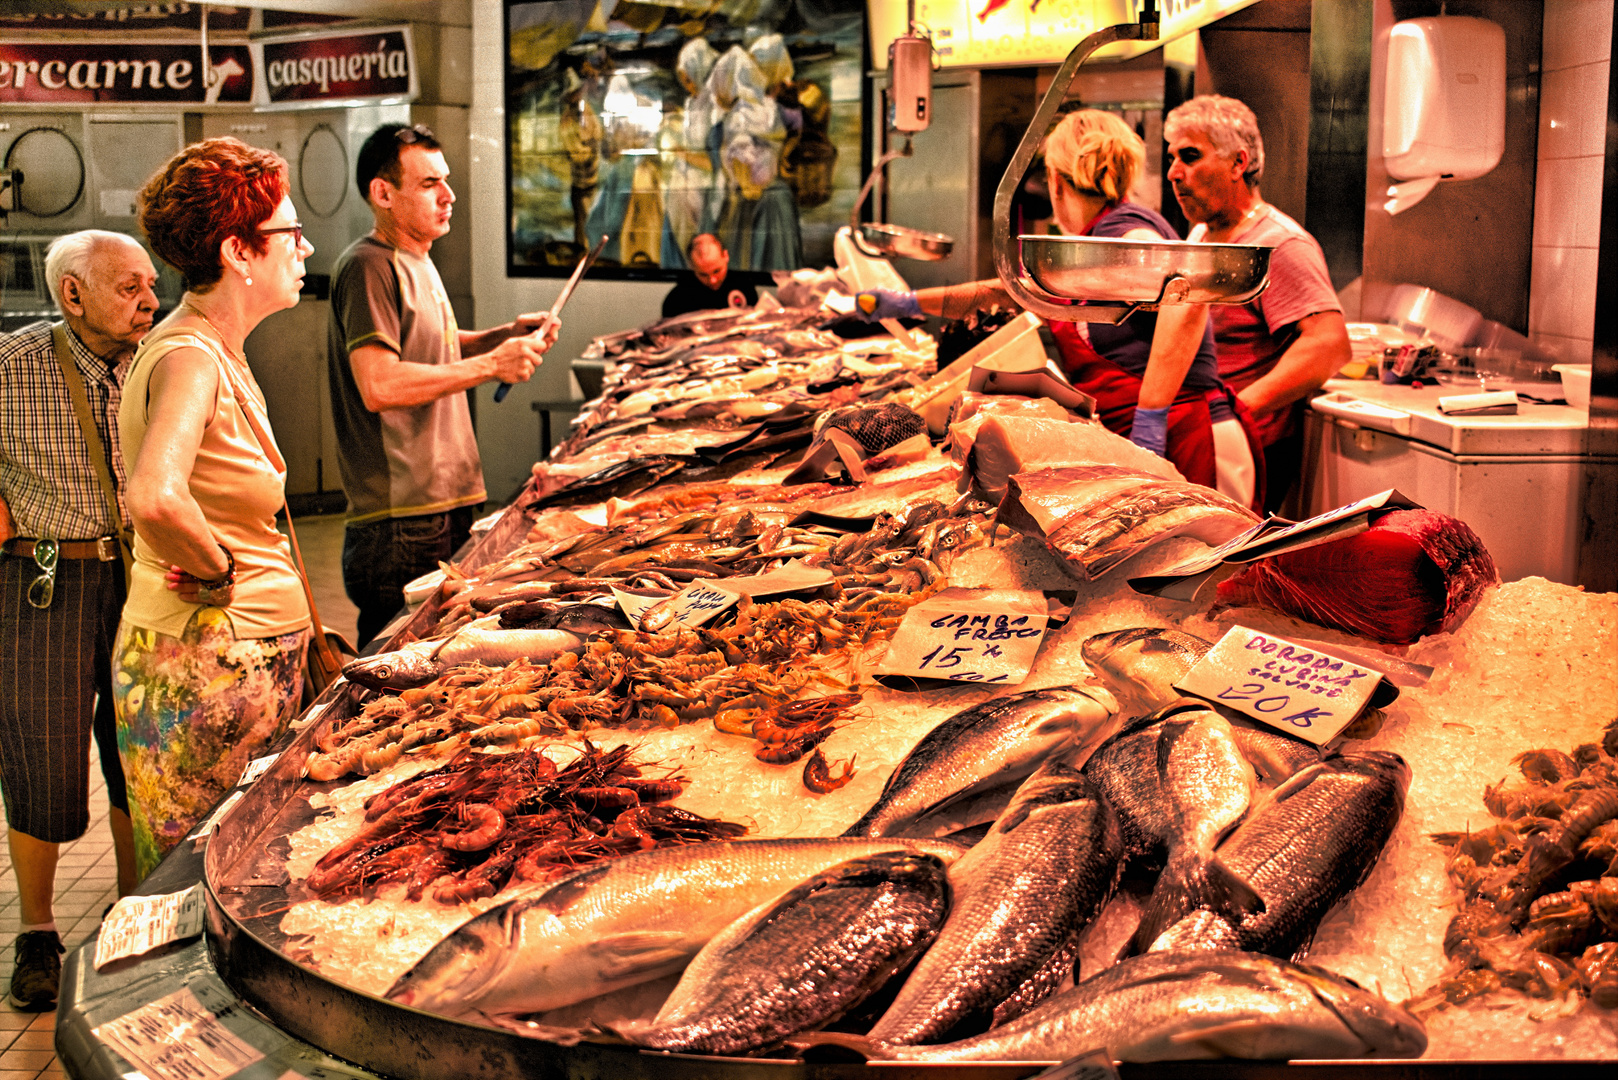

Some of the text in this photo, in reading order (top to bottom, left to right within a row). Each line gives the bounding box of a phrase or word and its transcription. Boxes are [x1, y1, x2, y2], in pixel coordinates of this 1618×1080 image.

[267, 39, 408, 94] casquería
[930, 614, 1029, 628] GAMBA
[918, 644, 973, 670] 15
[1245, 635, 1368, 680] DORADA Y
[1217, 683, 1291, 713] 20
